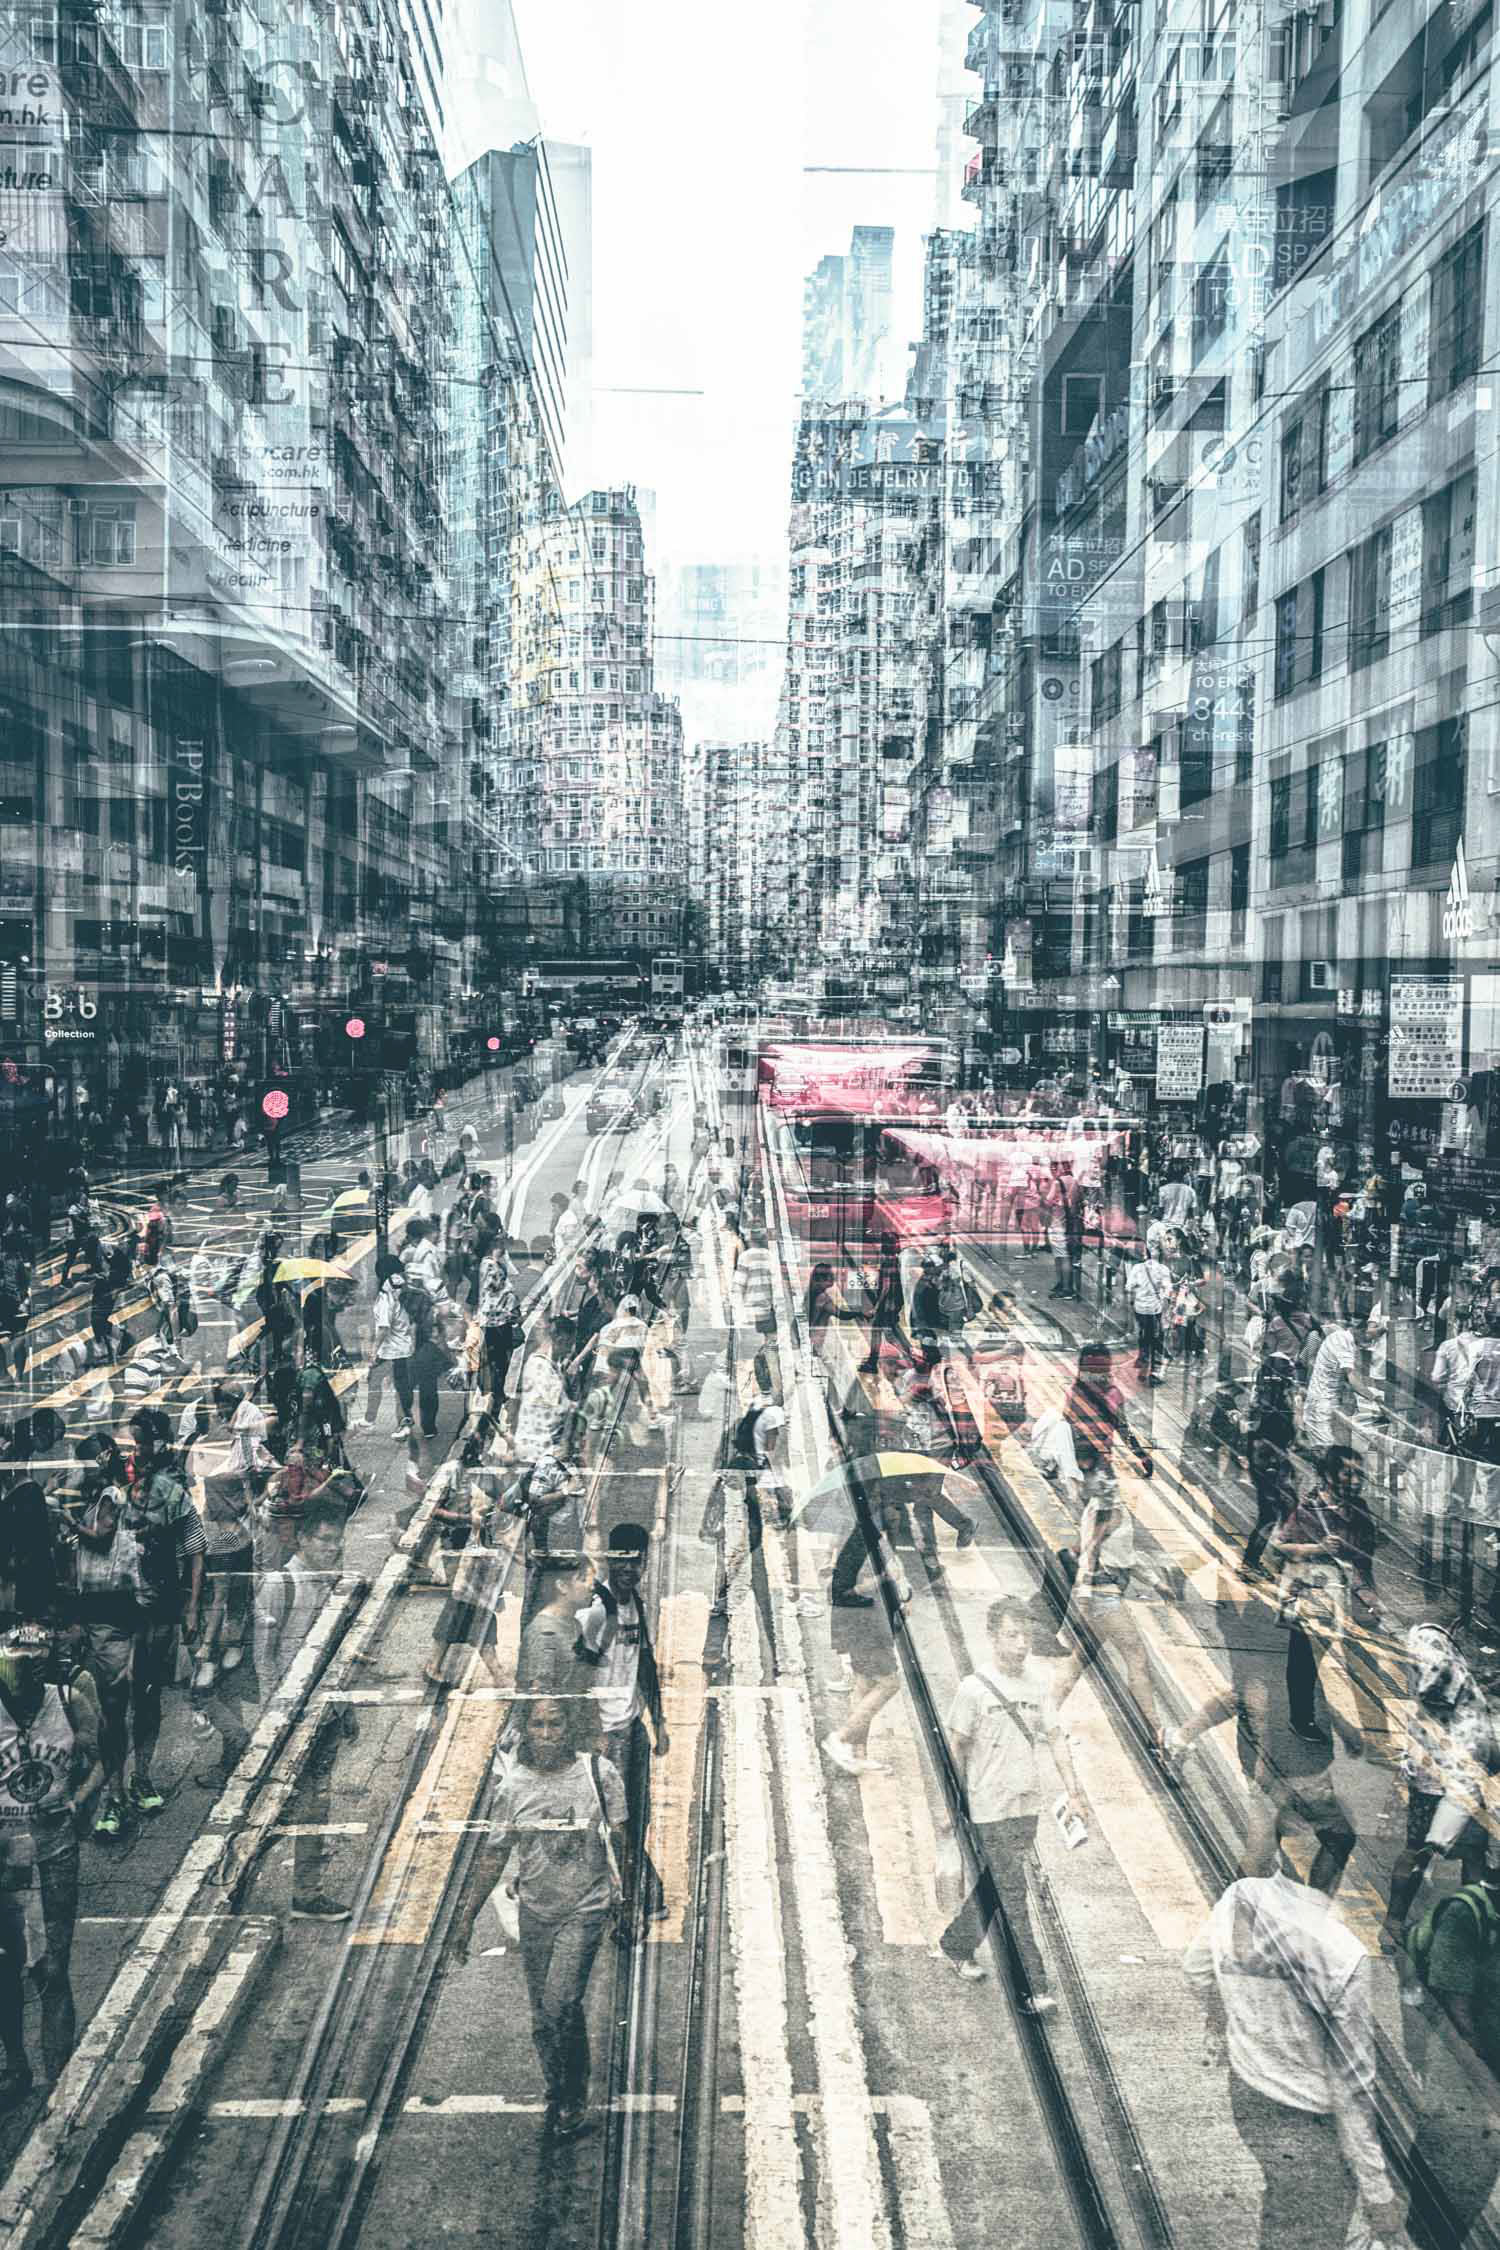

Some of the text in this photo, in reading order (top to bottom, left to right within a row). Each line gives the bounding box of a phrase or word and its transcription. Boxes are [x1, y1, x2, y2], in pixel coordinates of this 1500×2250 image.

[846, 470, 929, 489] JEWELRY
[1047, 558, 1086, 581] AD
[174, 783, 205, 877] Books
[44, 1029, 95, 1039] Collection
